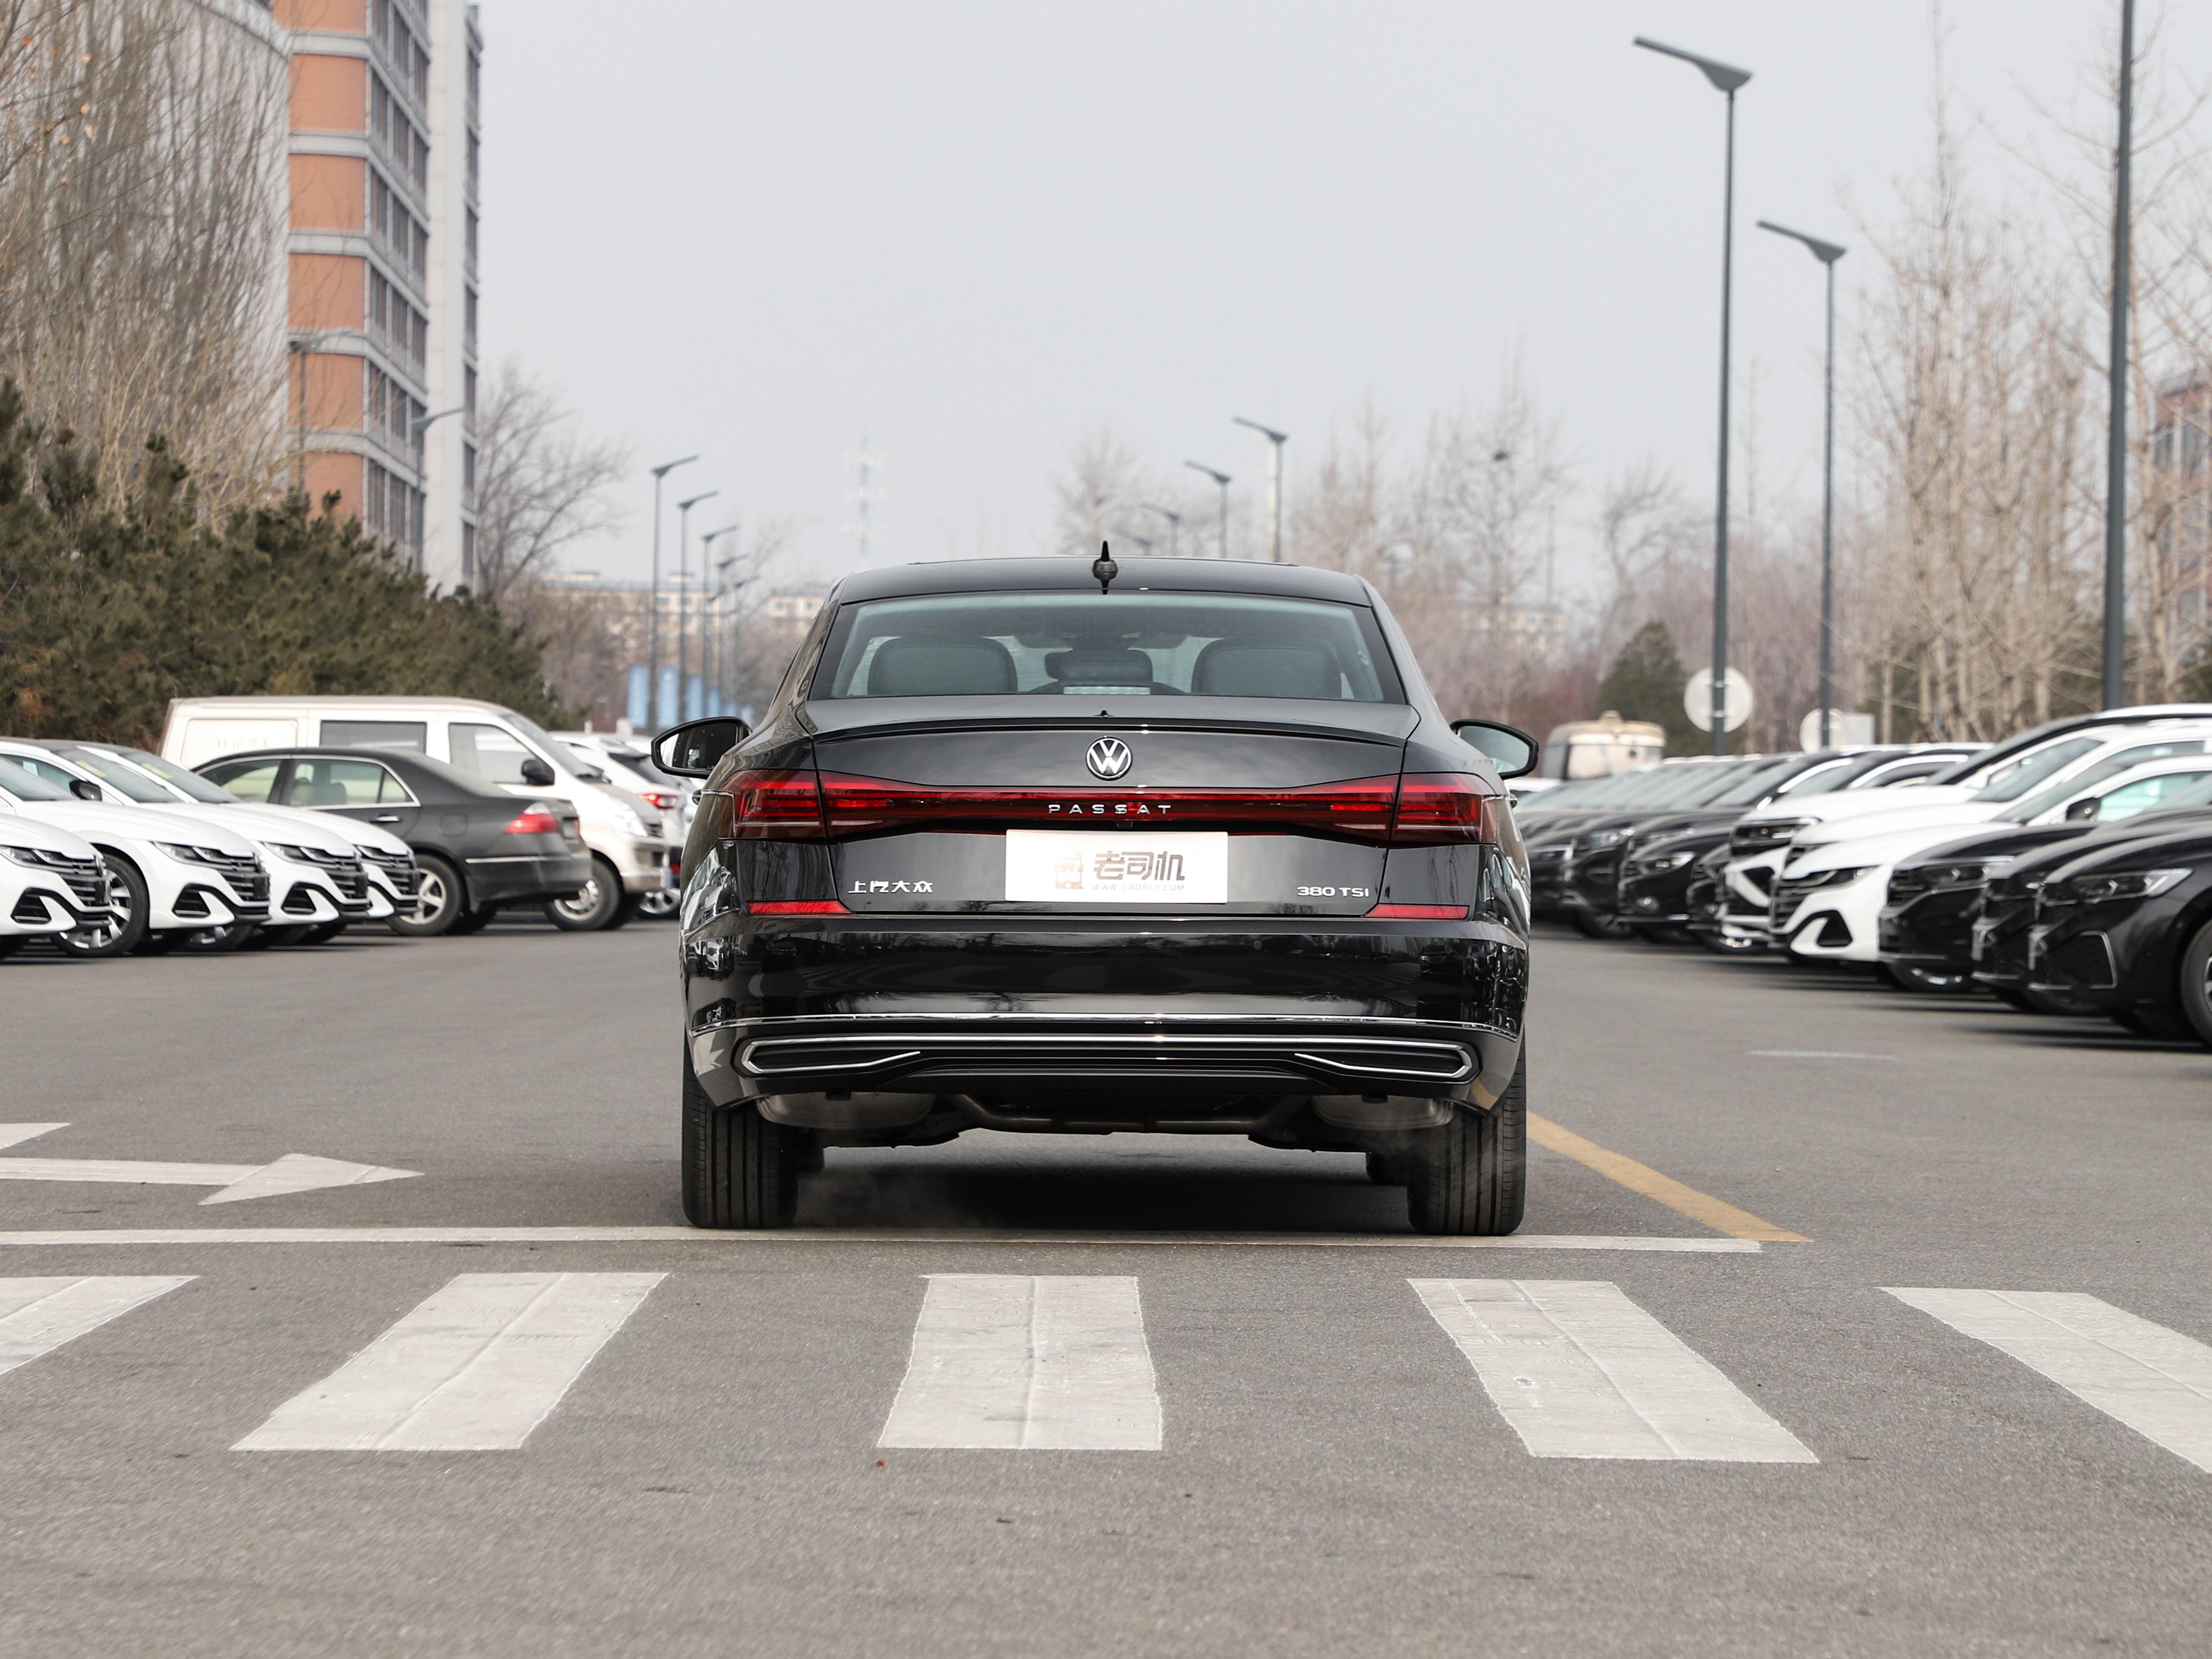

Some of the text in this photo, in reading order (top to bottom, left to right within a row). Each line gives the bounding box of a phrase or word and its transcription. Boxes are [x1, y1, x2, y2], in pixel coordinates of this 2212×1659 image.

[1048, 804, 1171, 814] PASSAT
[1093, 850, 1185, 881] 老司机
[848, 880, 934, 893] 上汽大众
[1297, 886, 1369, 897] 380 TSI
